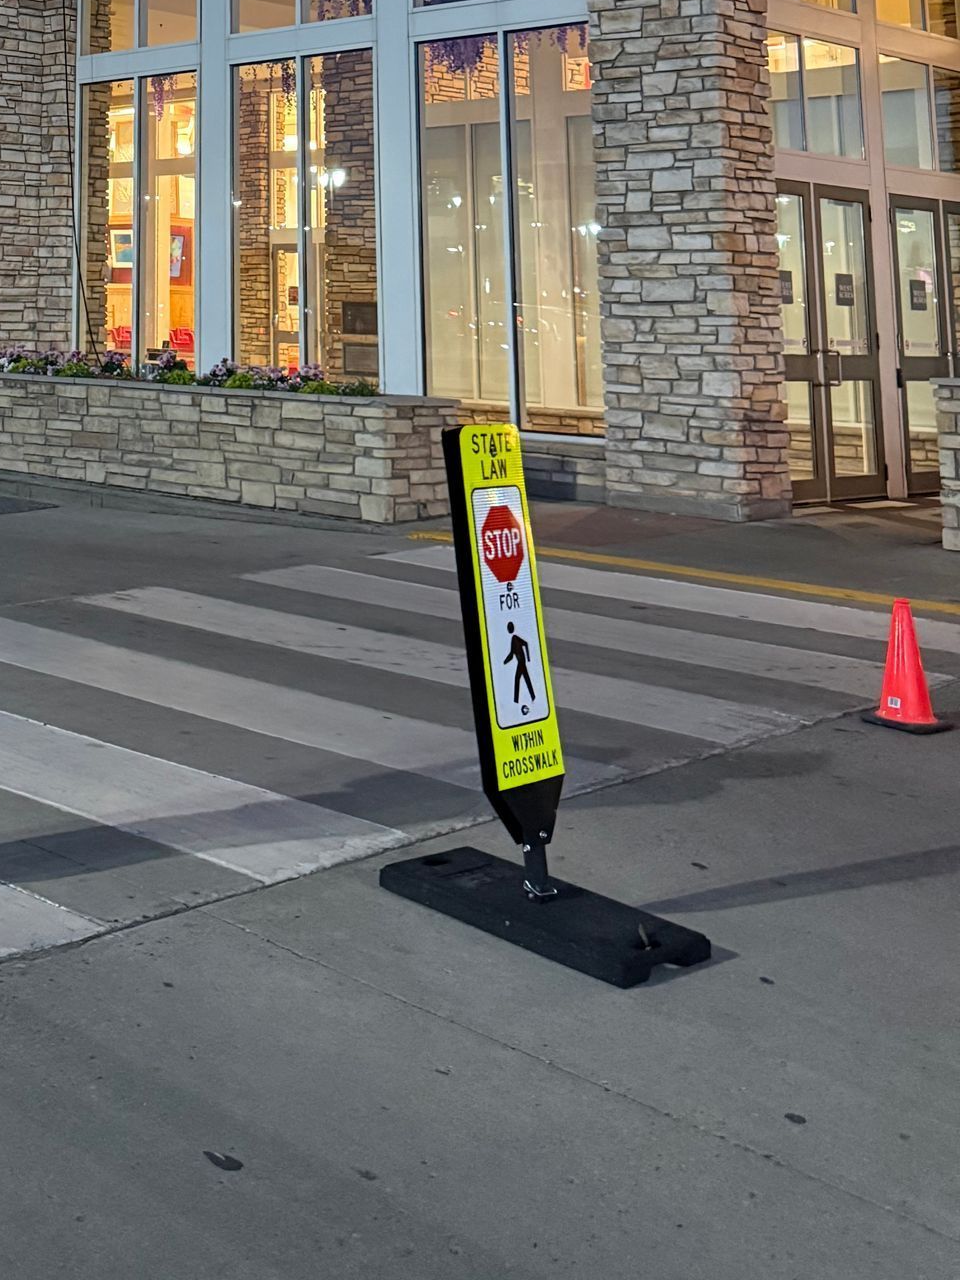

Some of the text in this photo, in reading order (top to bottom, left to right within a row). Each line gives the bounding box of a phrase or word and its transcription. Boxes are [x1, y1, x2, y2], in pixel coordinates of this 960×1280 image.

[471, 433, 511, 454] STATE
[481, 459, 507, 480] LAW
[484, 528, 520, 560] STOP
[499, 592, 520, 611] FOR
[511, 729, 544, 751] WITHIN
[502, 749, 558, 778] CROSSWALK
